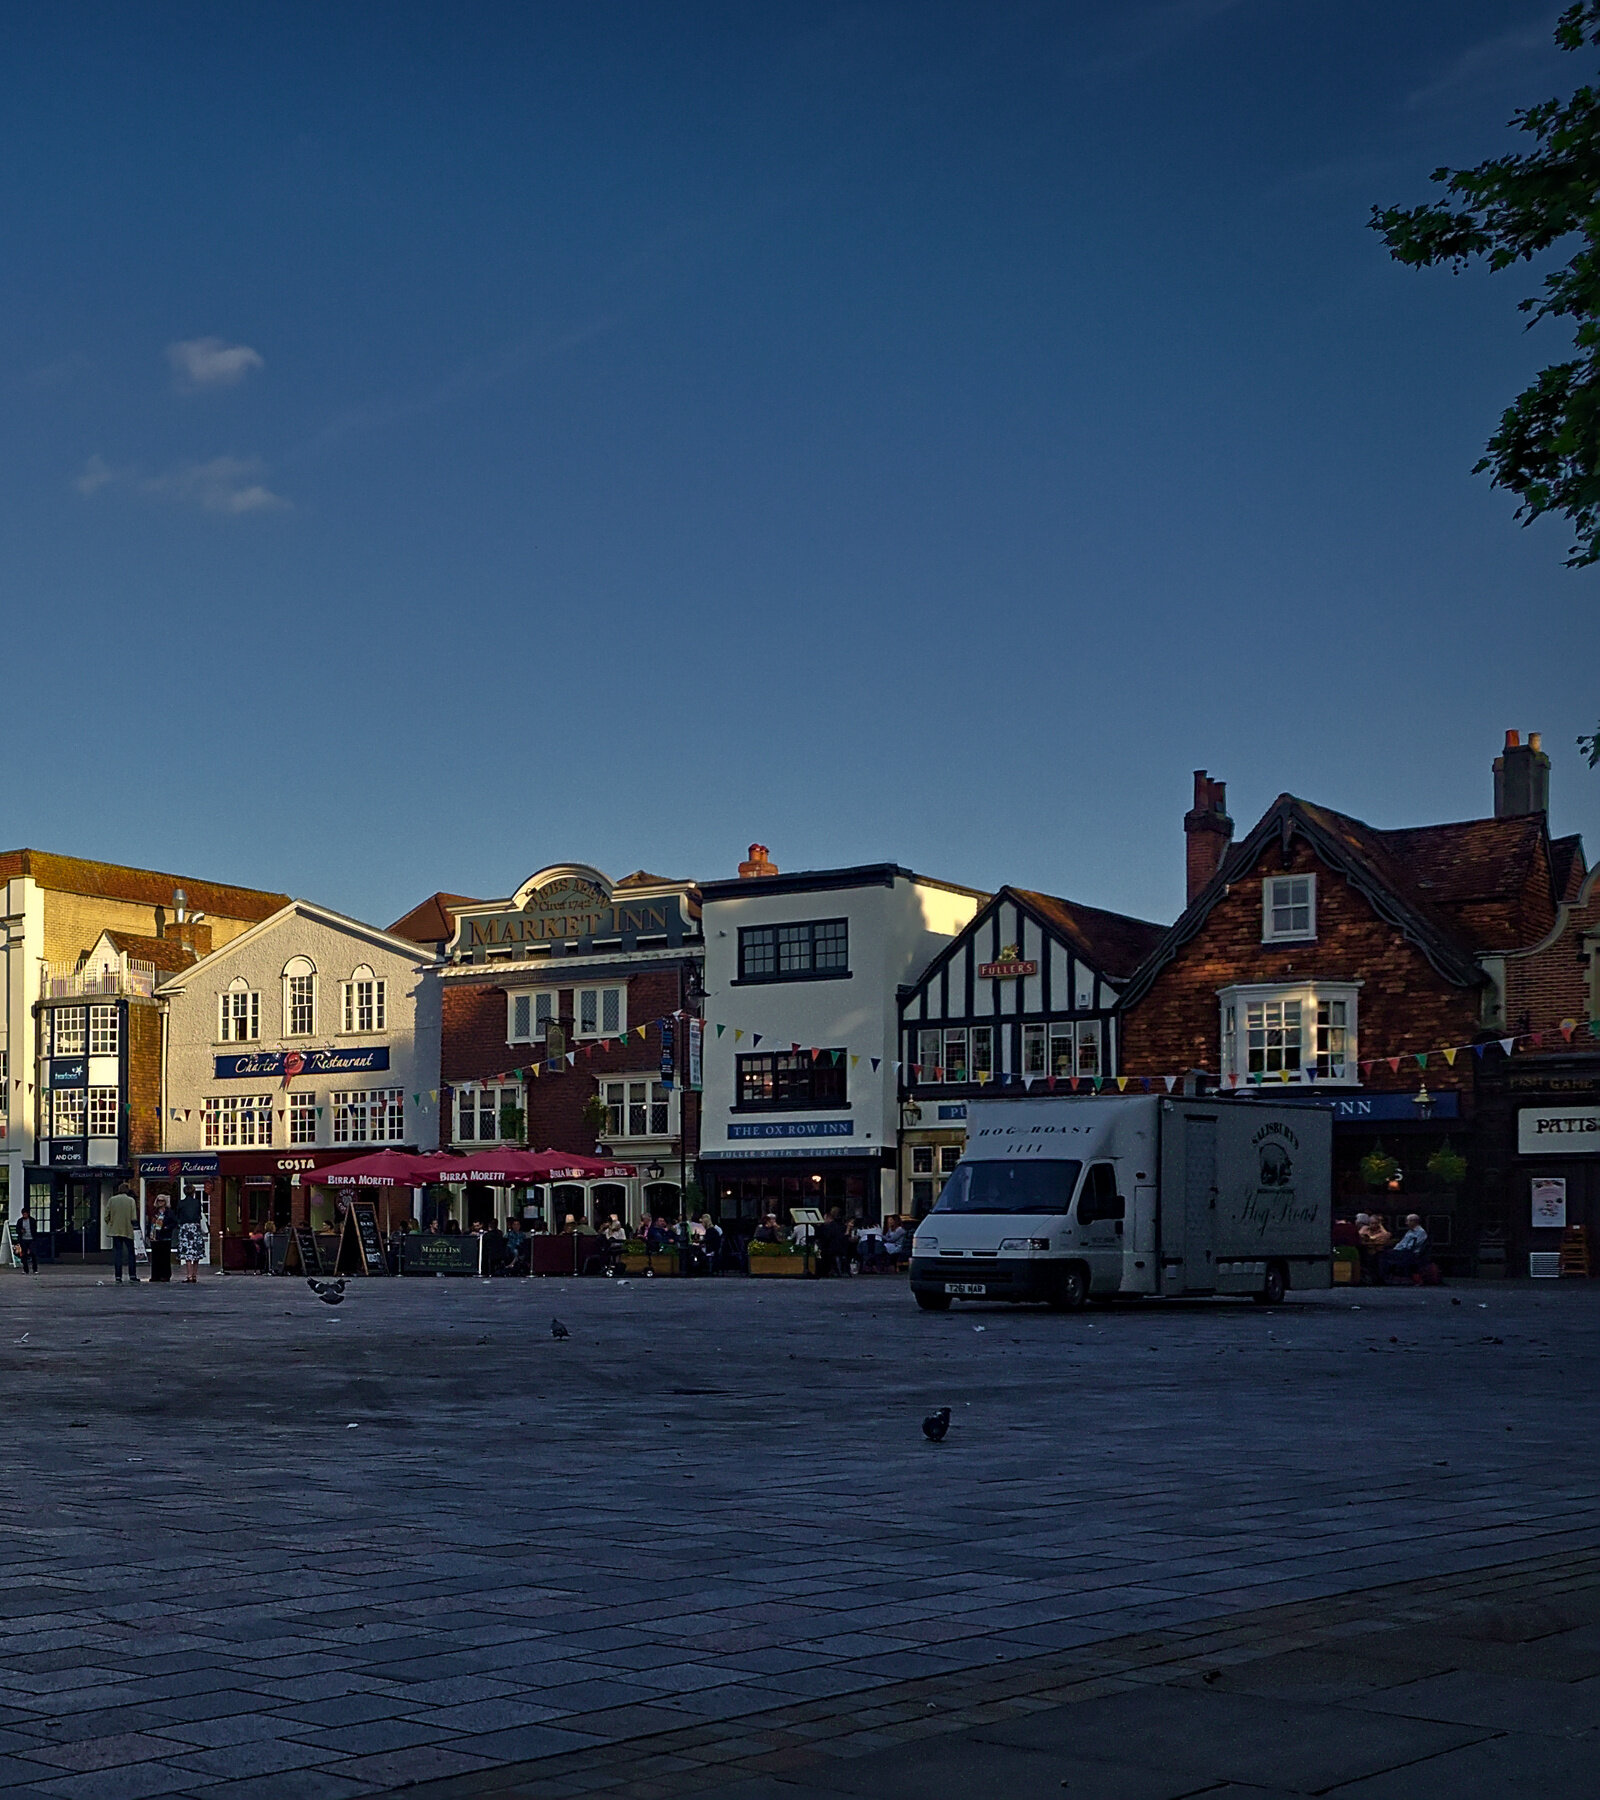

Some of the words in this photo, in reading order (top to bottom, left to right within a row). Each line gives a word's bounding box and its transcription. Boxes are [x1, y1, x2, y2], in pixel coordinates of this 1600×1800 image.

[539, 900, 566, 911] Circa
[468, 911, 604, 946] MARKET
[609, 905, 669, 933] INN
[234, 1057, 279, 1074] Charter
[309, 1052, 374, 1070] Restaurant
[733, 1126, 760, 1136] THE
[765, 1125, 783, 1135] OX
[788, 1124, 818, 1135] ROW
[823, 1123, 848, 1133] INN
[1536, 1117, 1600, 1133] PATIS
[978, 1126, 1016, 1136] HOG
[1030, 1126, 1095, 1134] ROAST
[139, 1162, 167, 1172] Charter
[181, 1161, 218, 1172] Restaurant
[277, 1158, 315, 1170] COSTA
[327, 1175, 357, 1184] BIRRA
[358, 1175, 394, 1186] MORETTI
[439, 1172, 468, 1181] BIRRA
[470, 1170, 505, 1180] MORETTI
